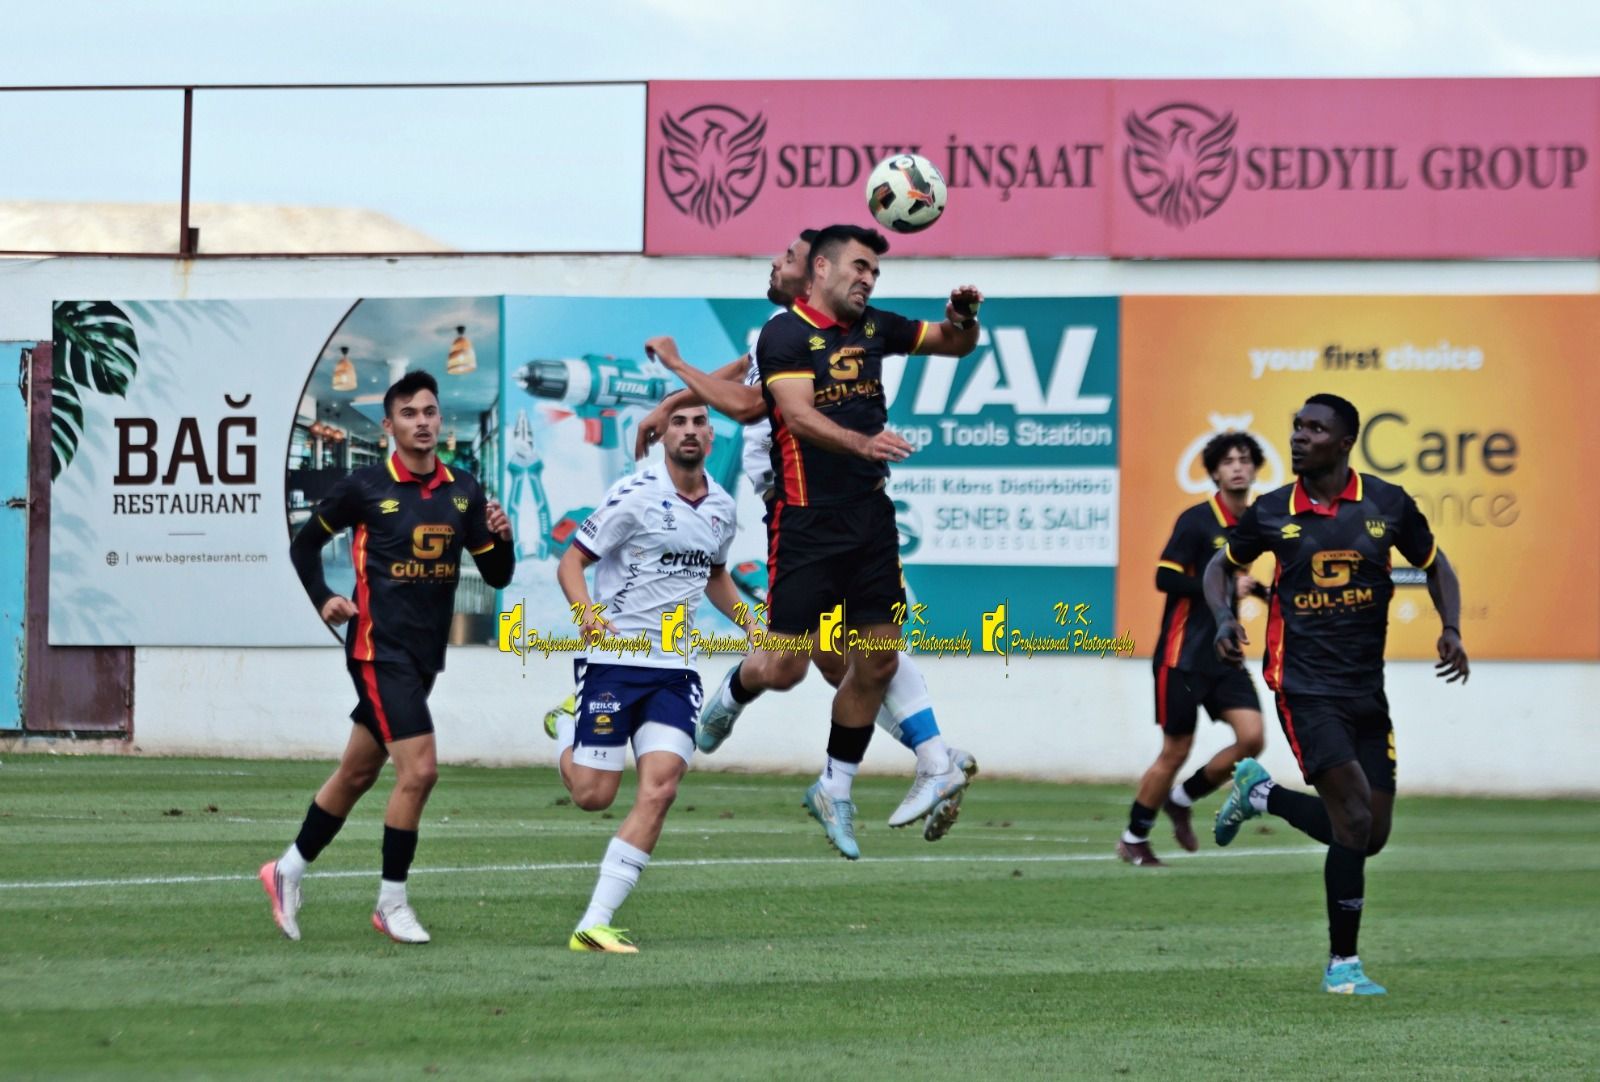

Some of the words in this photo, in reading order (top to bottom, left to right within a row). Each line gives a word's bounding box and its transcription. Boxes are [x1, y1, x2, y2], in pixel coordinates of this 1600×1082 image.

[776, 144, 922, 188] SEDY
[946, 134, 1103, 202] İNŞAAT
[1243, 145, 1407, 191] SEDYIL
[1420, 145, 1588, 191] GROUP
[1249, 347, 1318, 379] your
[1323, 345, 1382, 369] first
[1385, 342, 1484, 370] choice
[113, 393, 257, 486] BAĞ
[940, 420, 1010, 447] Tools
[1015, 420, 1113, 447] Station
[1361, 411, 1519, 475] Care
[892, 478, 935, 495] etkili
[113, 493, 261, 515] RESTAURANT
[1018, 505, 1033, 531] &
[135, 553, 268, 565] www.bagrestaurant.com
[391, 560, 456, 578] GÜL-EM
[1294, 588, 1373, 609] GÜL-EM
